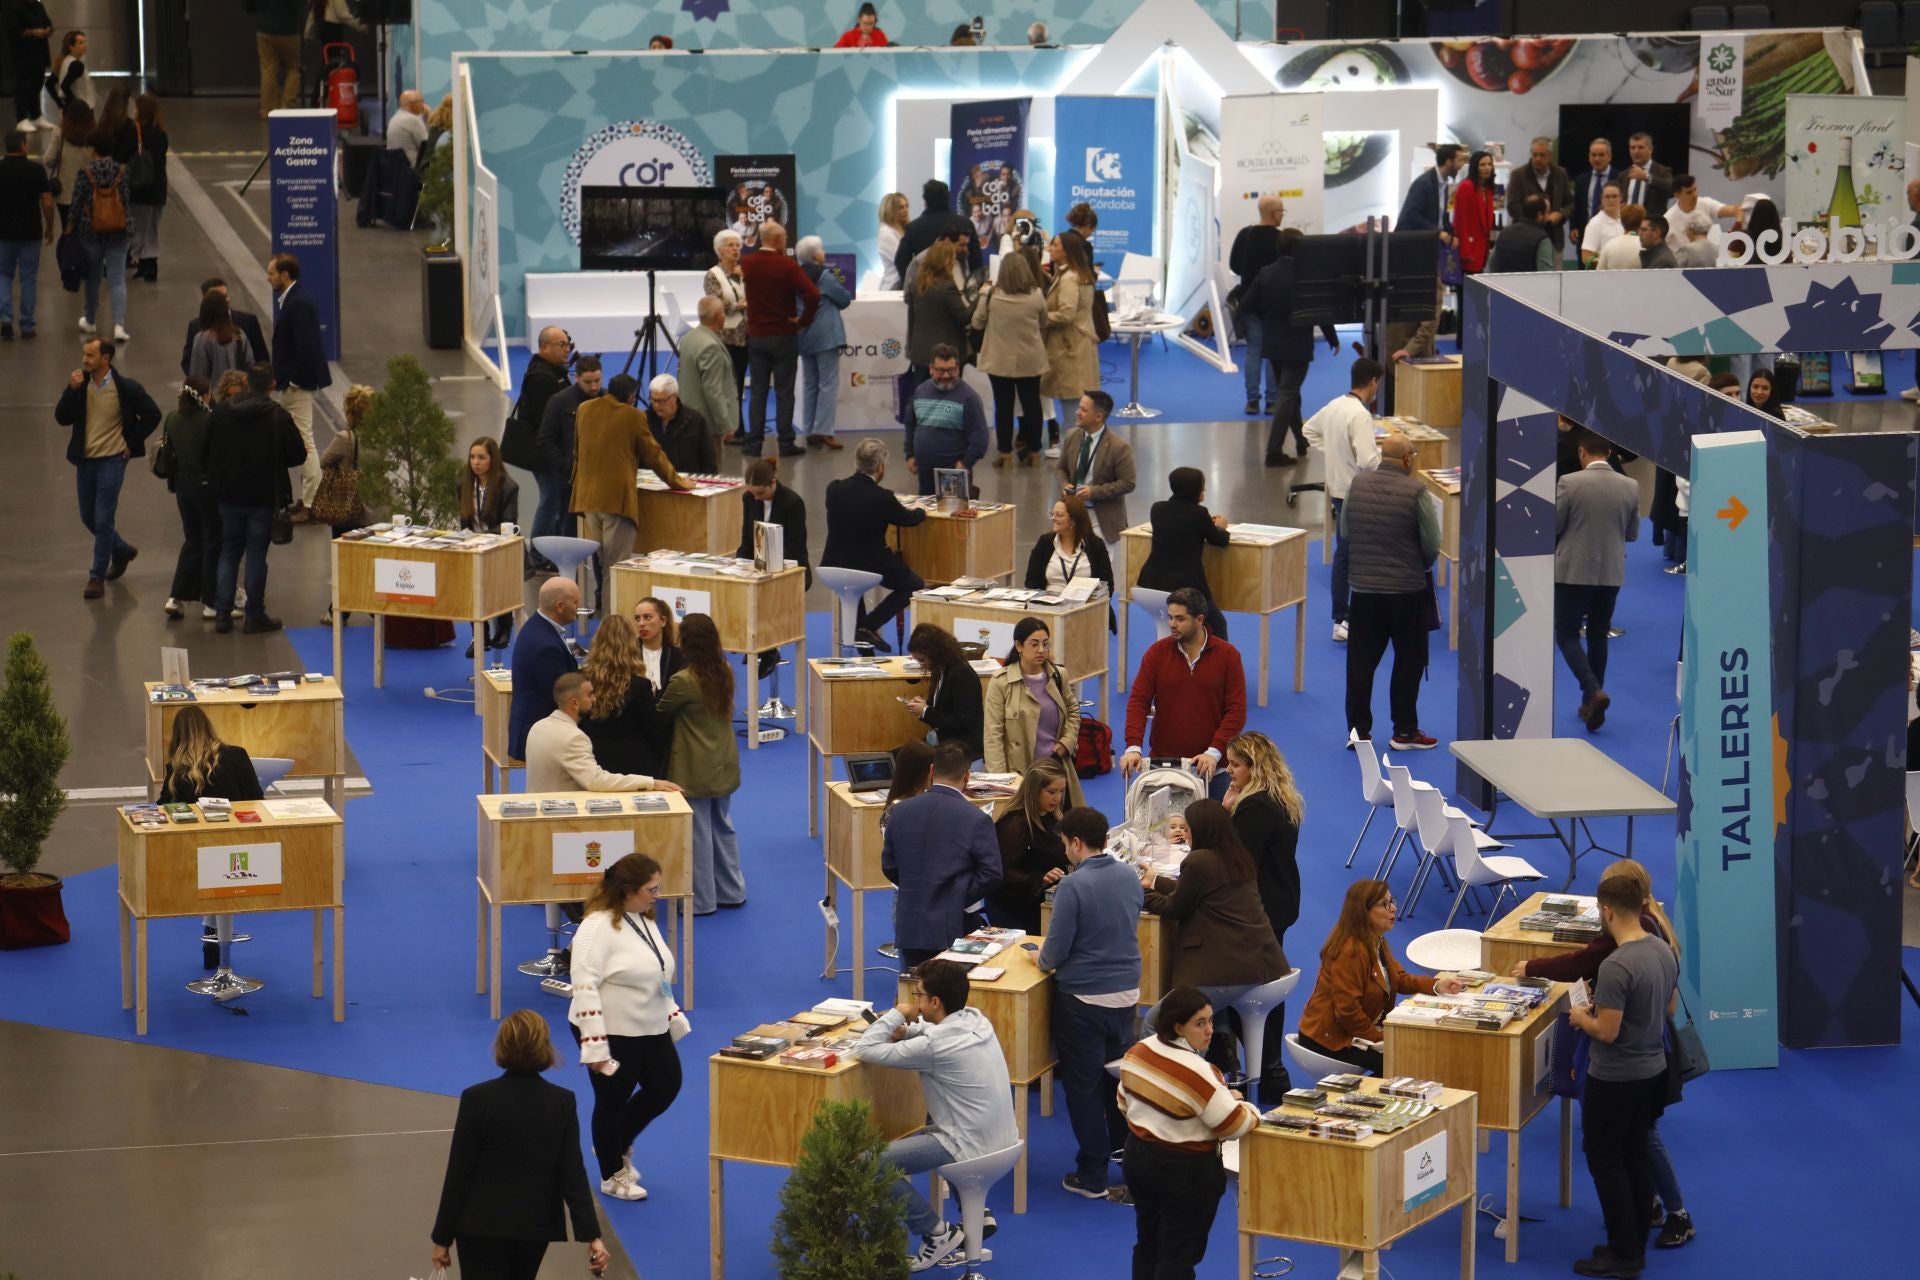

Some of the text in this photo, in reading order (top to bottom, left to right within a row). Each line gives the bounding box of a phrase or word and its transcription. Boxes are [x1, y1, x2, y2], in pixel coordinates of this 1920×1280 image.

[1706, 75, 1736, 89] gusto
[1715, 86, 1736, 97] Sur
[290, 137, 313, 145] Zona
[274, 147, 328, 156] Actividades
[286, 158, 318, 167] Gastro
[1071, 185, 1136, 199] Diputación
[1089, 198, 1136, 210] Córdoba
[865, 345, 877, 356] a
[395, 581, 415, 591] Espejo
[1720, 647, 1751, 871] TALLERES
